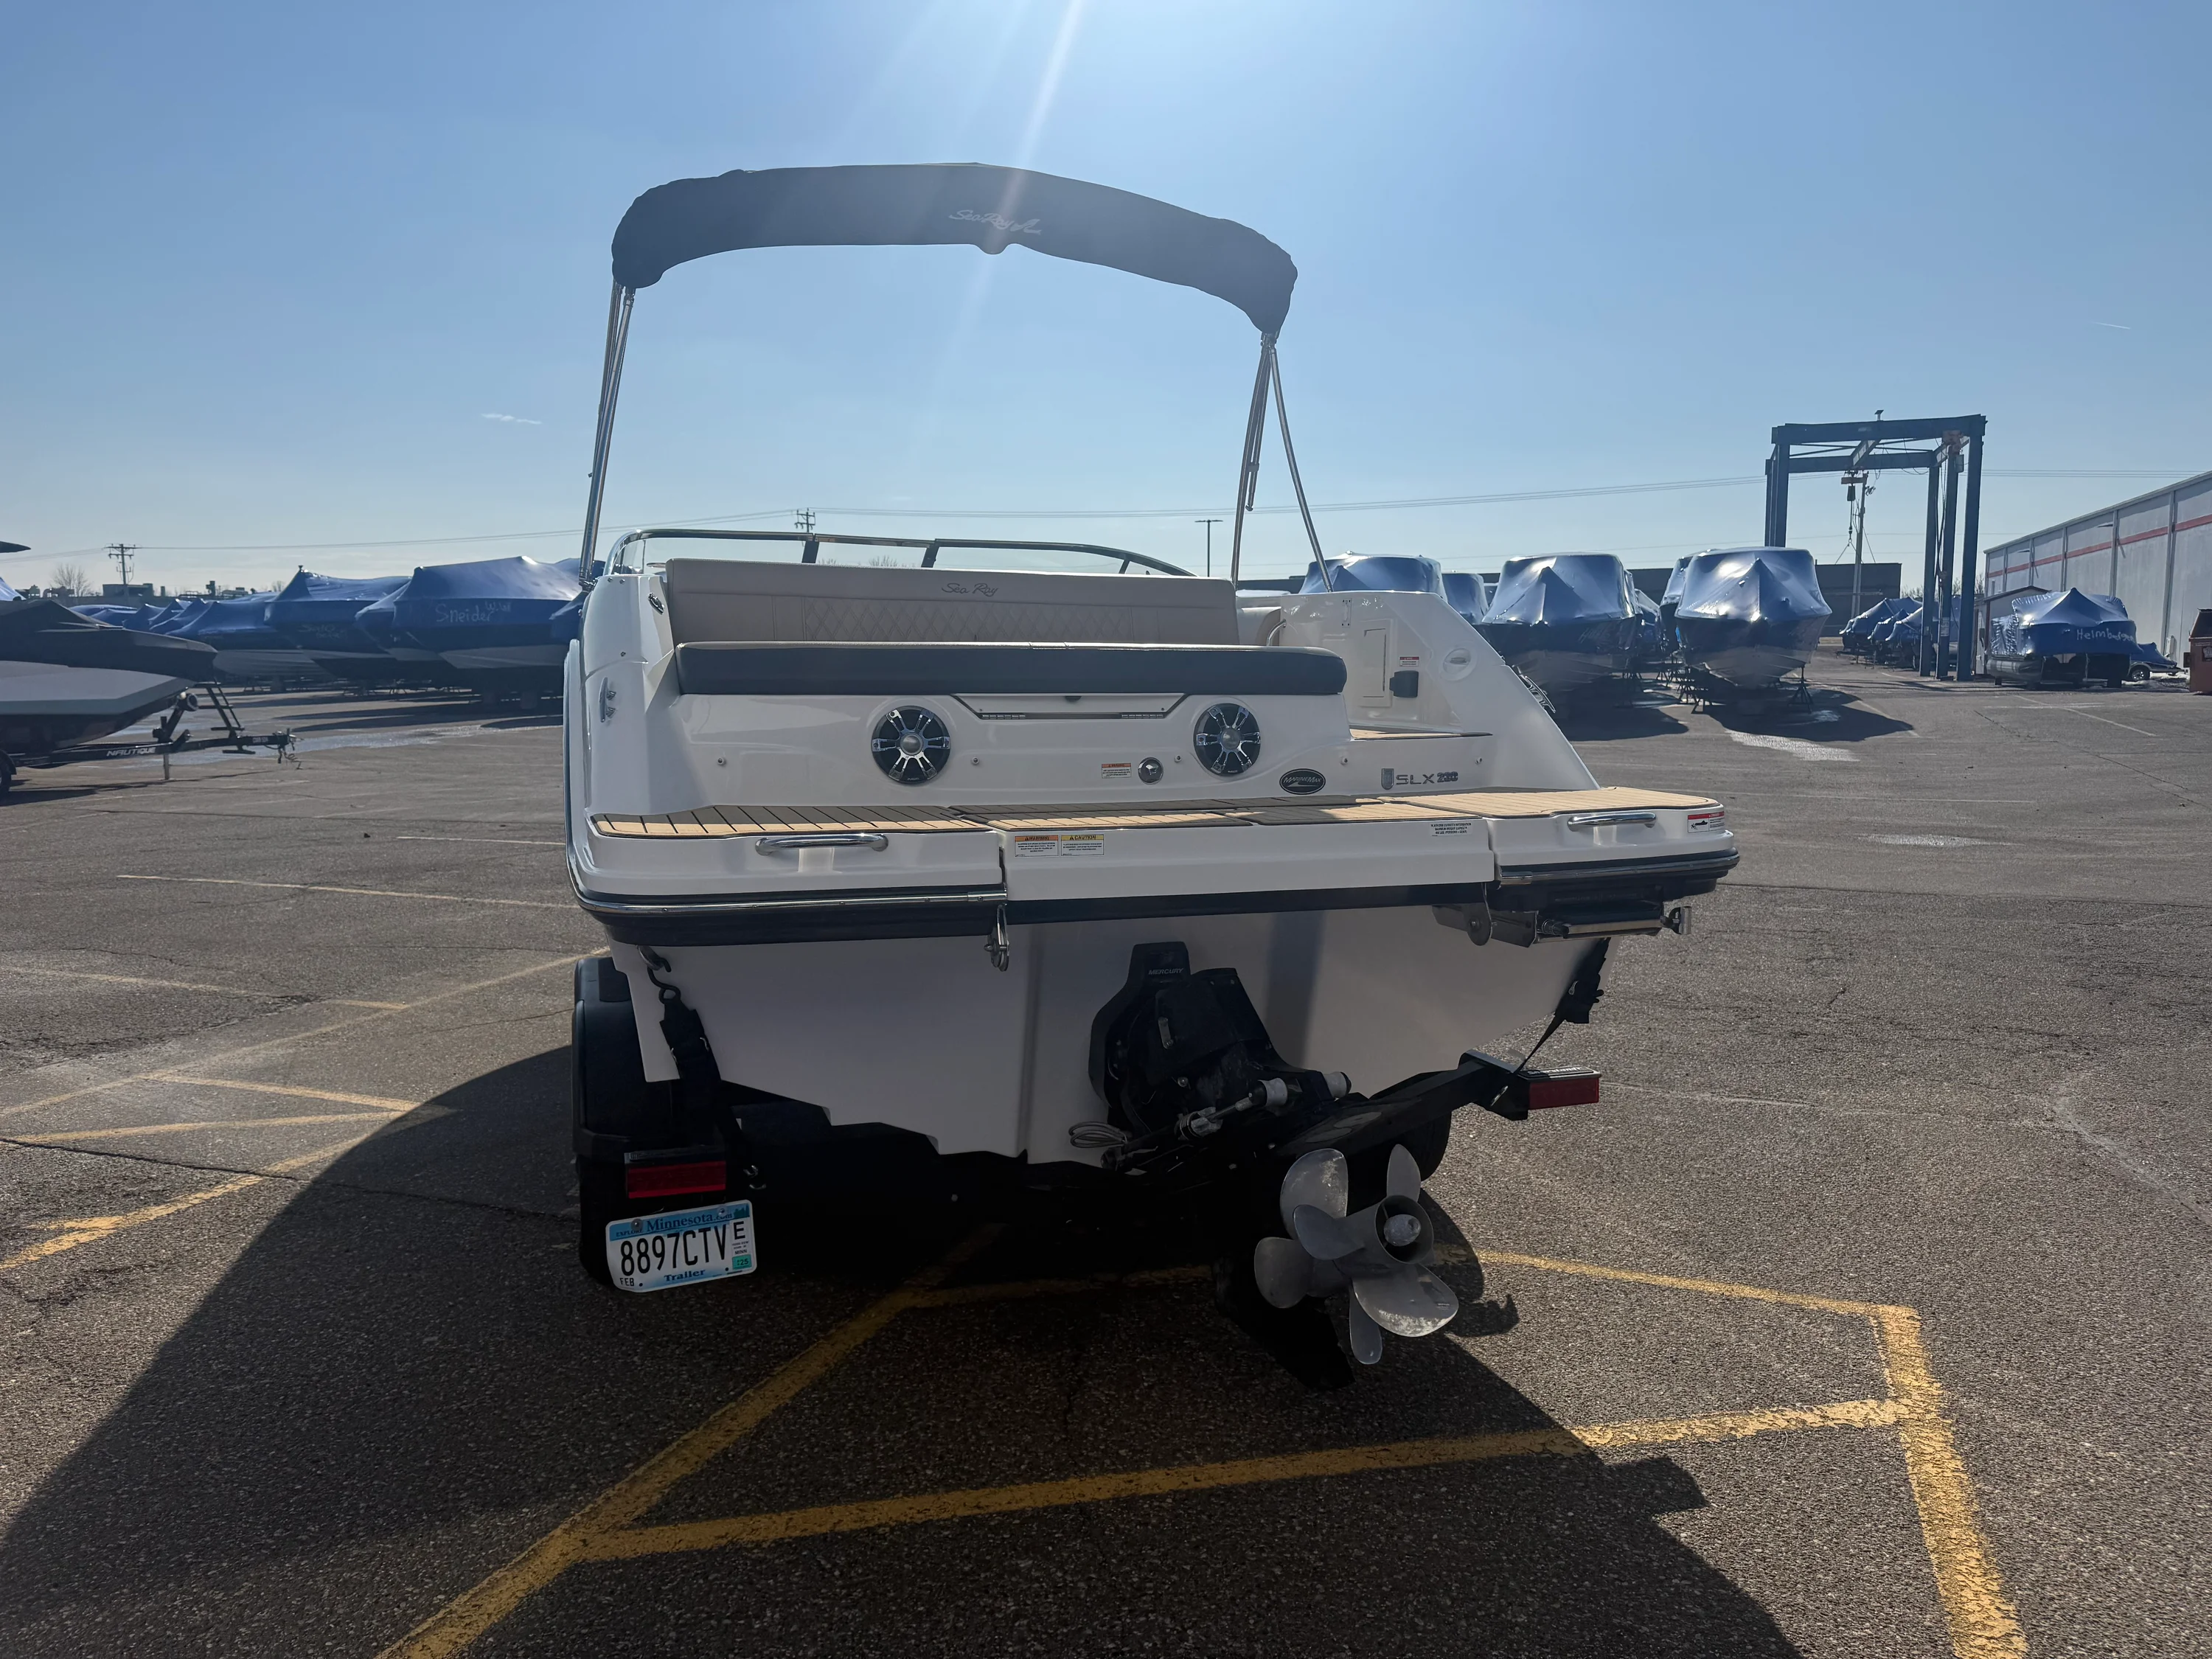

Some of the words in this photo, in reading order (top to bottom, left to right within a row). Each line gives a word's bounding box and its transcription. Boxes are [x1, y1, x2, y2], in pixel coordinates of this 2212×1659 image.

[942, 582, 970, 594] Sea
[972, 582, 998, 597] Ray
[435, 603, 494, 622] Sneider
[106, 747, 156, 757] NAUTIQUE
[1396, 773, 1435, 785] SLX
[664, 1268, 706, 1282] Trailer
[619, 1277, 635, 1287] FEB
